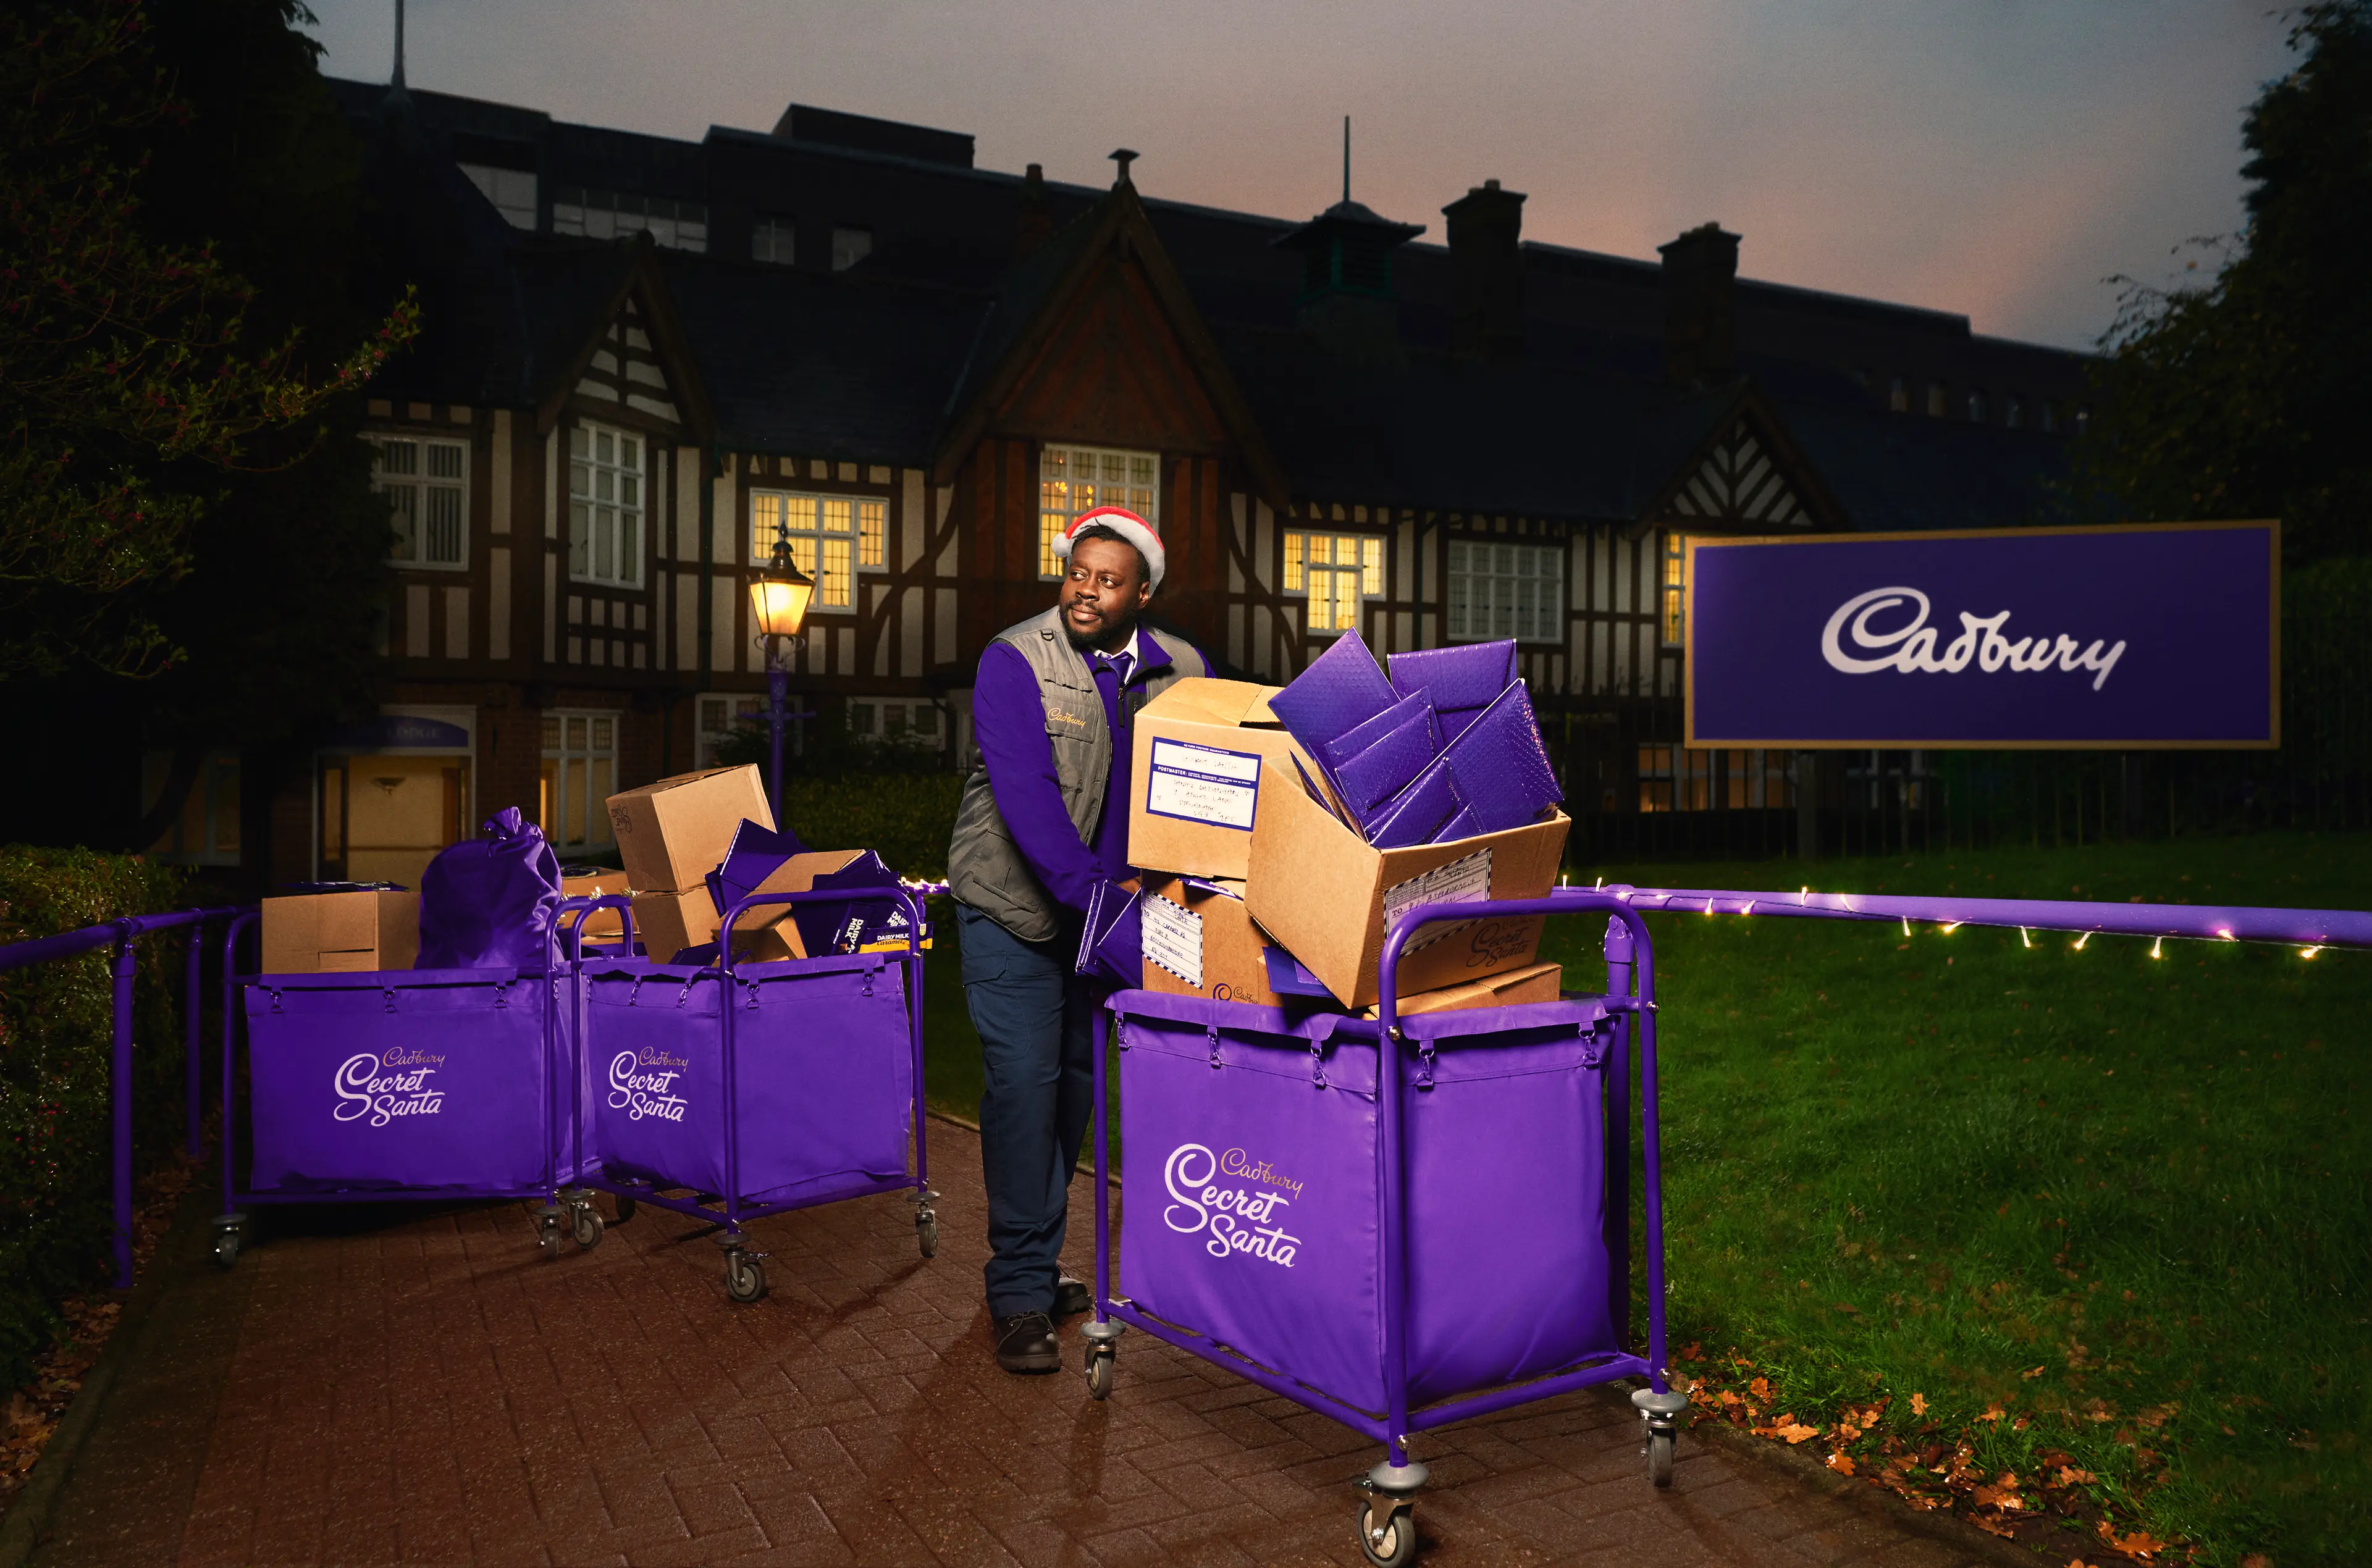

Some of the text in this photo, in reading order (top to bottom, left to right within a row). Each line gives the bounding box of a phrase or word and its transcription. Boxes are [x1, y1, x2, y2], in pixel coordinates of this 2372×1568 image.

[1821, 586, 2126, 691] Cadbury
[1047, 707, 1087, 729] Cadbury
[1158, 766, 1187, 776] POSTMASTER:
[891, 911, 909, 926] DAIR
[1144, 909, 1150, 917] TO
[1392, 908, 1403, 916] TO
[845, 918, 856, 938] MILK
[852, 919, 864, 944] DAIRY
[1466, 923, 1530, 967] Secret
[1486, 940, 1532, 967] Santa
[1234, 986, 1258, 1005] Cadbur
[383, 1046, 445, 1067] Cadbury
[639, 1046, 689, 1073] Cadbury
[334, 1053, 436, 1121] Secret
[608, 1050, 680, 1109] Secret
[370, 1089, 445, 1127] Santa
[629, 1092, 688, 1122] Santa
[1221, 1147, 1303, 1200] Cadbury
[1164, 1143, 1290, 1233] Secret
[1206, 1214, 1302, 1268] Santa
